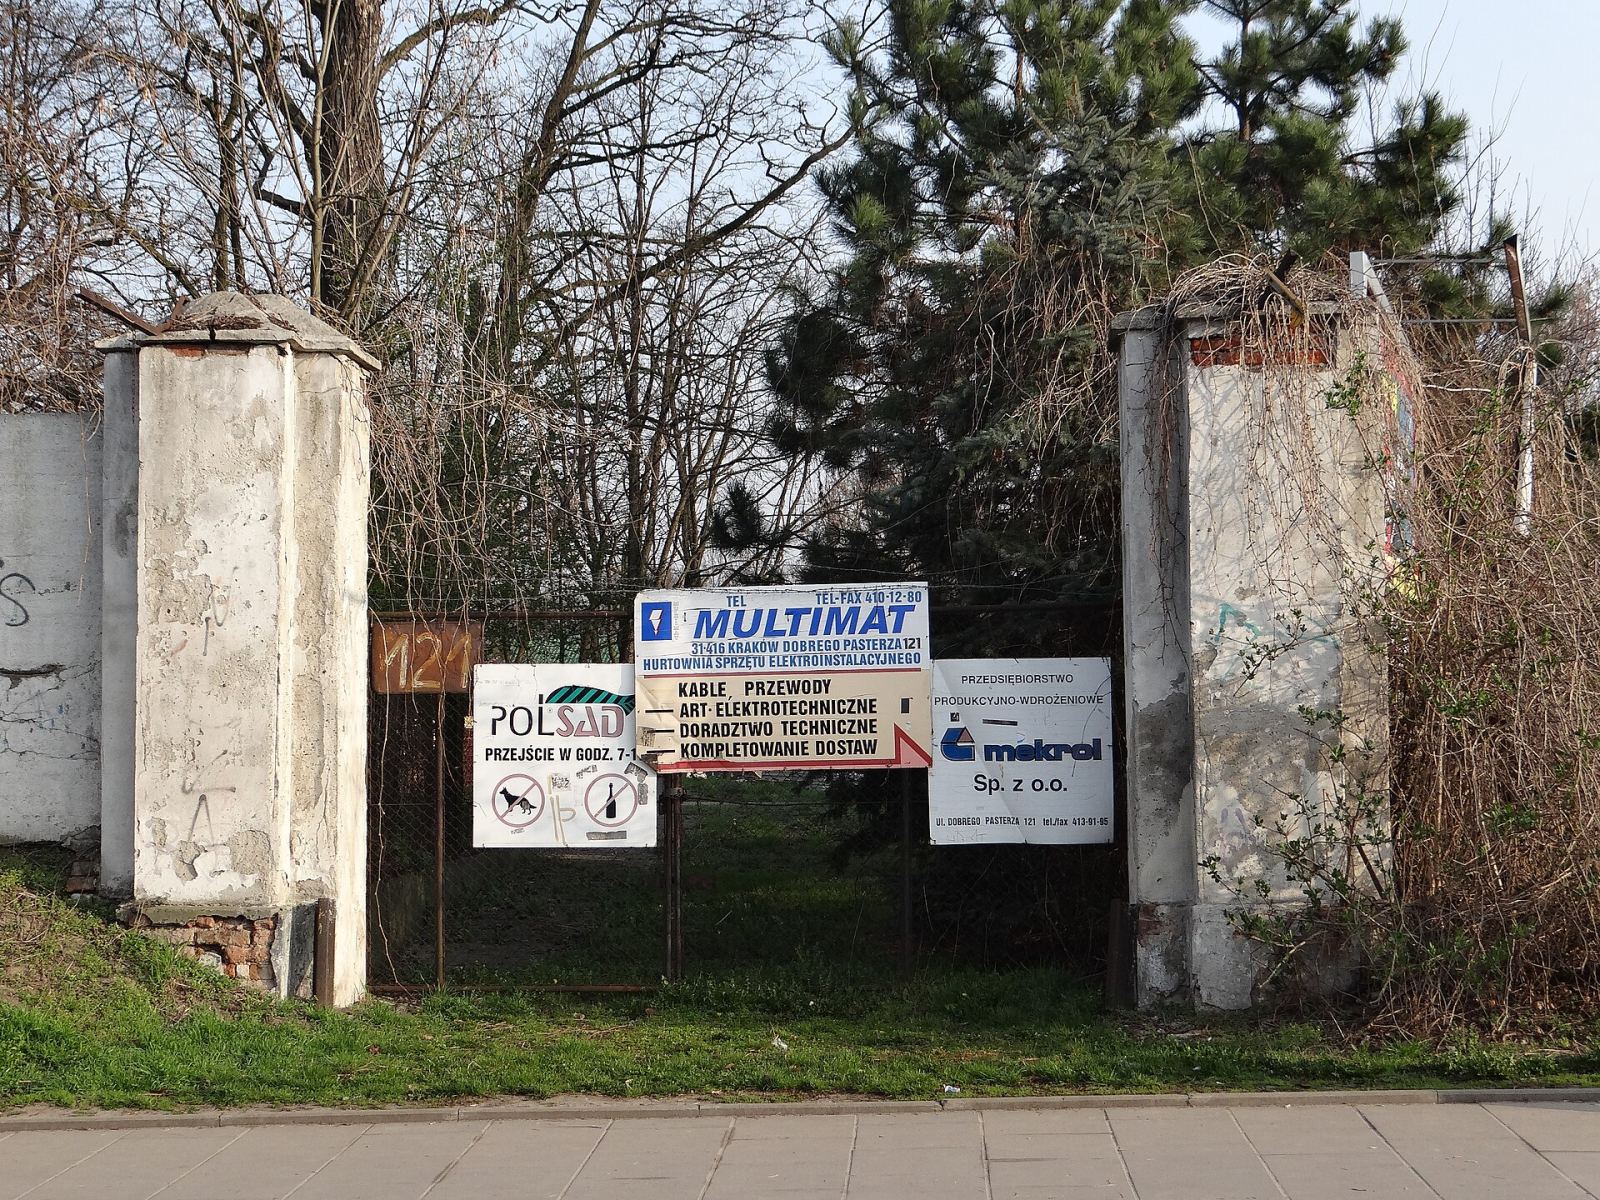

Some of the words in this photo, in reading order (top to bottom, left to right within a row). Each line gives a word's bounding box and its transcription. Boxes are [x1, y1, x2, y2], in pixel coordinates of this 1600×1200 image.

[726, 595, 747, 607] TEL
[816, 592, 861, 605] TEL-FAX
[693, 604, 916, 639] MULTIMAT
[728, 638, 778, 654] KRAKÓW
[783, 639, 840, 653] DOBREGO
[843, 638, 902, 651] PASTERZA
[903, 637, 921, 649] 121
[384, 632, 472, 688] 121
[643, 657, 713, 671] HURTOWNIA
[715, 655, 765, 671] SPRZĘTU
[769, 652, 921, 669] ELEKTROINSTALACYJNEGO
[678, 682, 733, 700] KABLE,
[744, 679, 832, 697] PRZEWODY
[961, 674, 1074, 686] PRZEDSIĘBIORSTWO
[716, 698, 877, 718] ELEKTROTECHNICZNE
[934, 694, 1104, 706] PRODUKCYJNO-WDROŻENIOWE
[680, 721, 773, 738] DORADZTWO
[780, 719, 877, 736] TECHNICZNE
[485, 744, 555, 762] PRZEJŚCIE
[560, 748, 571, 761] W
[576, 747, 614, 761] GODZ.
[618, 748, 637, 761] 7-1
[681, 740, 810, 758] KOMPLETOWANIE
[815, 739, 878, 755] DOSTAW
[984, 738, 1103, 762] mekrol
[973, 774, 1005, 795] Sp.
[1012, 778, 1024, 792] z
[1031, 778, 1068, 792] o.o.
[948, 817, 981, 826] DOBREGO
[985, 816, 1020, 826] PASTERZA
[1024, 817, 1036, 826] 121
